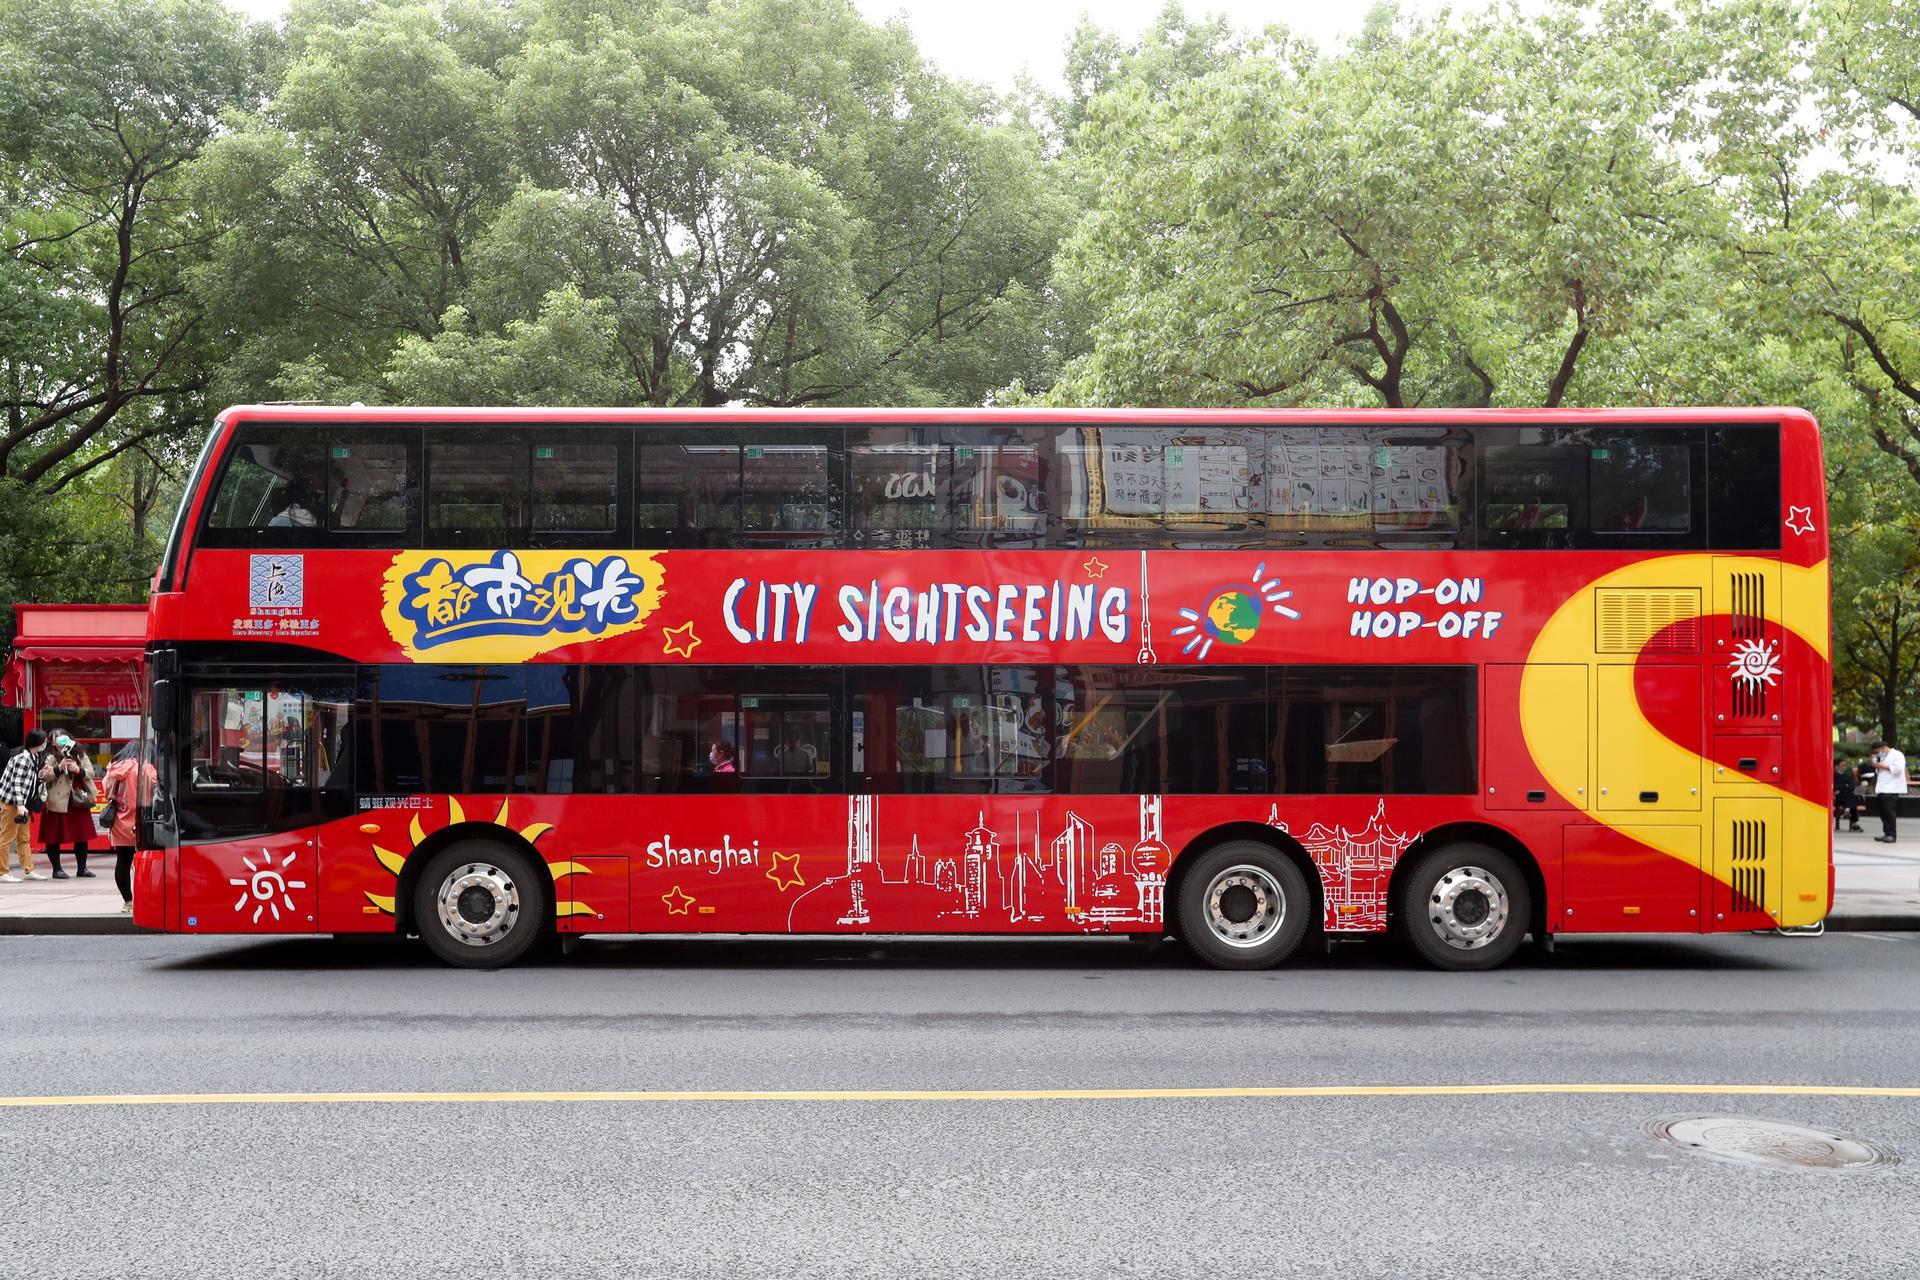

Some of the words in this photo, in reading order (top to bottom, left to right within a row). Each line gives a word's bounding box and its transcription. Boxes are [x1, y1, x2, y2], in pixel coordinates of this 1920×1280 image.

[266, 562, 287, 602] 上海
[409, 550, 642, 628] 都市观光
[1347, 577, 1485, 606] HOP-ON
[249, 607, 303, 617] Shanghai
[722, 577, 818, 645] CITY
[837, 579, 1129, 646] SIGHTSEEING
[1349, 610, 1503, 640] HOP-OFF
[359, 797, 433, 809] 蜻蜓观光巴士
[645, 833, 760, 875] Shanghai
